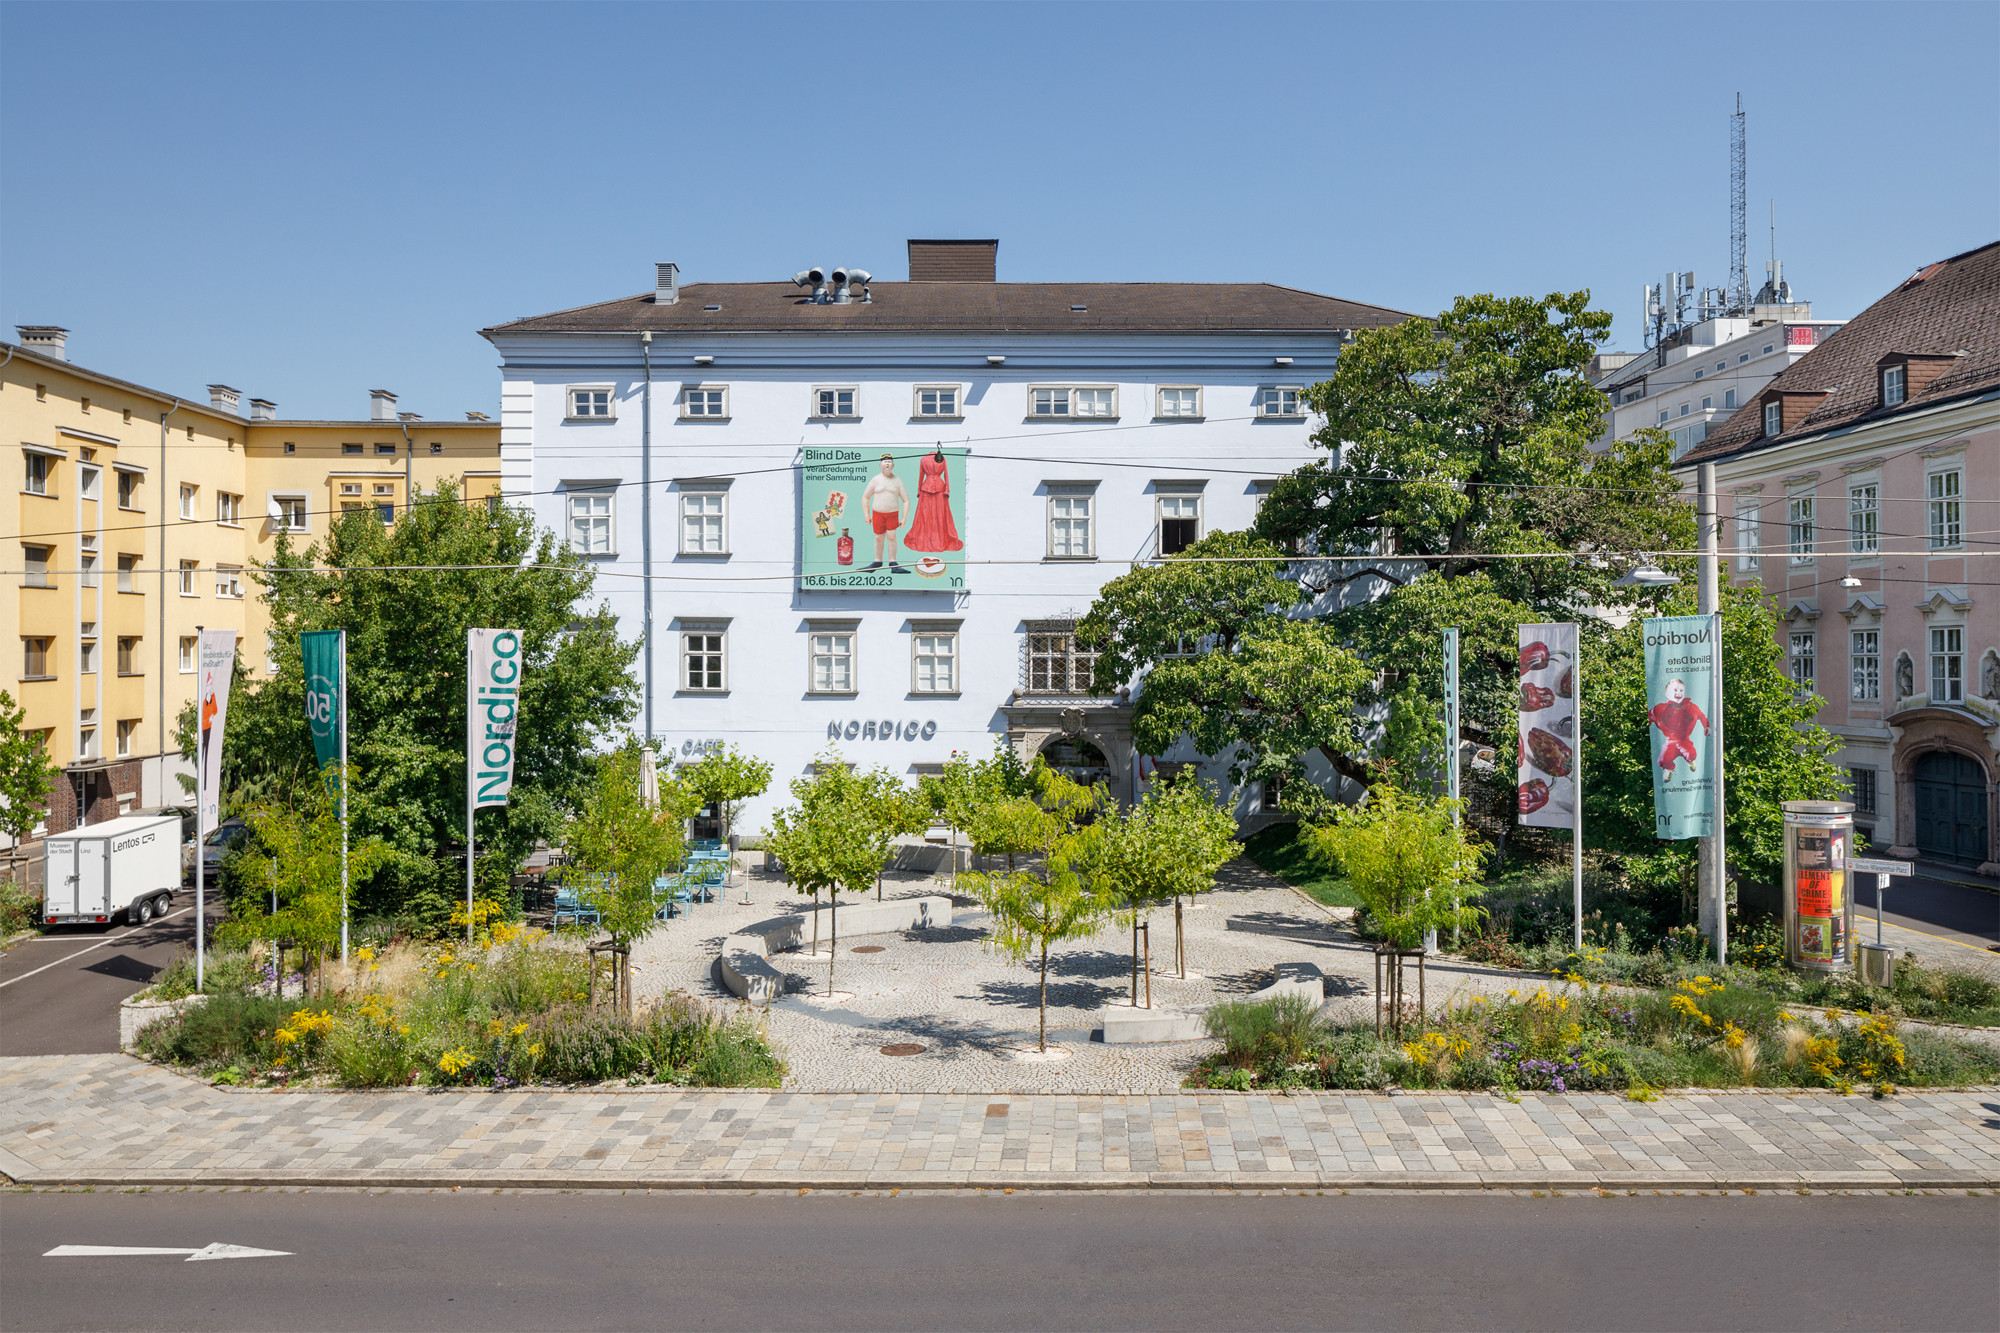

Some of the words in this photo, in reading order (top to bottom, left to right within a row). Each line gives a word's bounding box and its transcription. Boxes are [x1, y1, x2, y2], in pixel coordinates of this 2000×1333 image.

[1794, 329, 1810, 337] RIP
[1795, 337, 1810, 345] OFF
[805, 449, 833, 460] Blind
[835, 449, 862, 460] Date
[806, 465, 854, 474] Verabredung
[855, 465, 868, 473] mit
[805, 473, 825, 481] einer
[825, 473, 867, 483] Sammlung
[804, 575, 829, 586] 16.6.
[830, 575, 847, 586] bis
[848, 575, 893, 586] 22.10.23
[477, 632, 519, 803] Nordico
[827, 719, 938, 739] NORDICO
[112, 837, 140, 853] Lentos
[1798, 871, 1830, 880] ELEMENT
[1809, 880, 1820, 889] OF
[1801, 888, 1827, 898] CRIME
